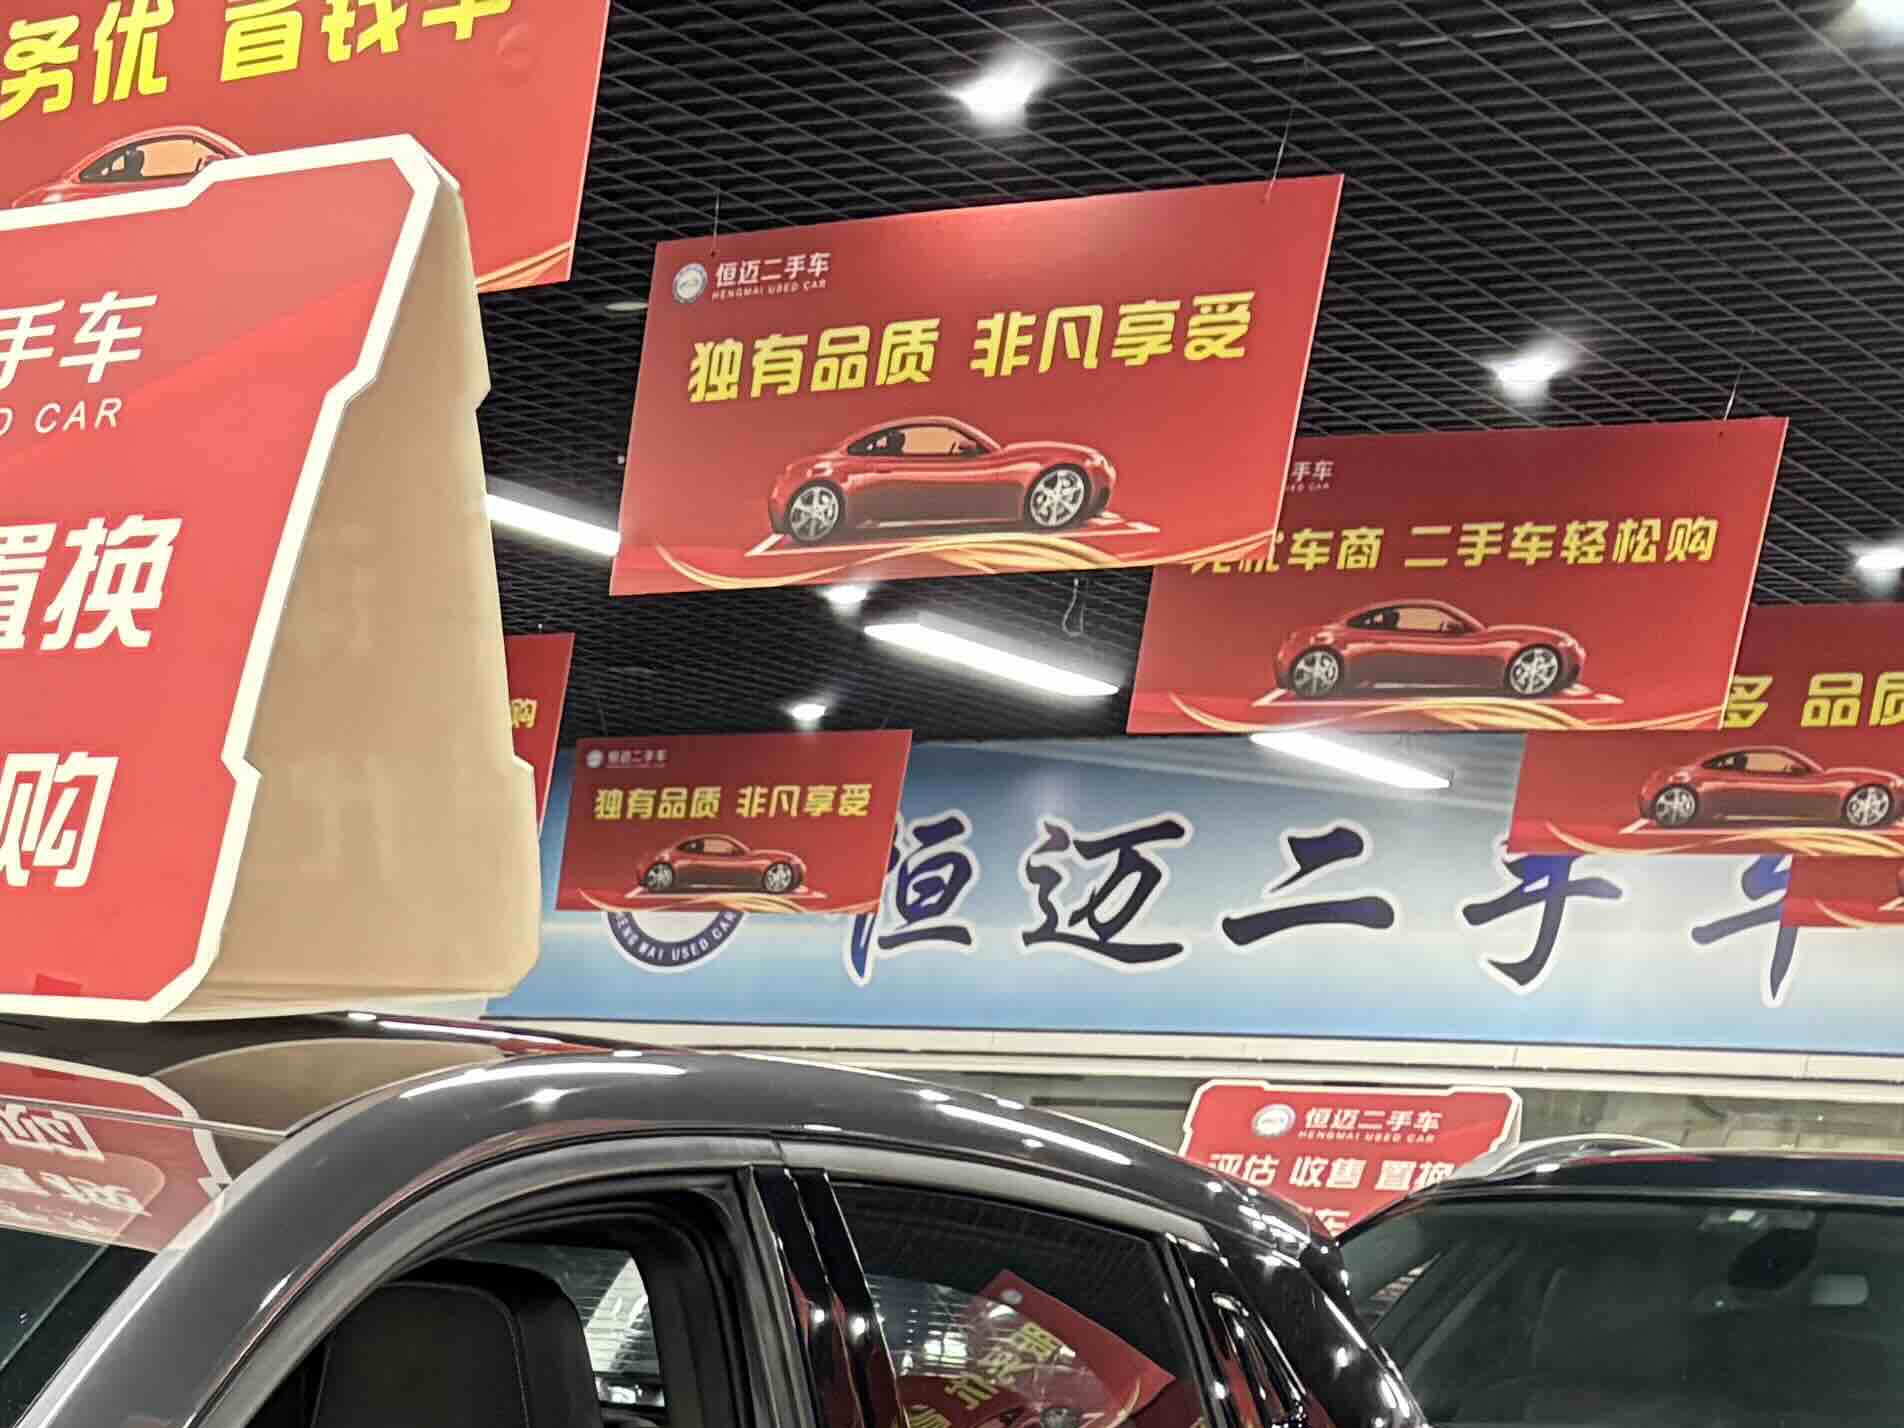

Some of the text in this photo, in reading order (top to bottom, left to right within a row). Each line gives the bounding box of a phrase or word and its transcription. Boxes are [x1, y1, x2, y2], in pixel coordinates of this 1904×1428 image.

[715, 252, 832, 288] 恒迈二手车
[688, 290, 1254, 402] 独有品质 非凡享受
[34, 397, 123, 434] CAR
[1404, 517, 1718, 569] 二手车轻松购
[594, 784, 872, 819] 独有品质 非凡享受
[1305, 1107, 1443, 1132] 恒迈二手车
[1290, 1157, 1366, 1188] 收售
